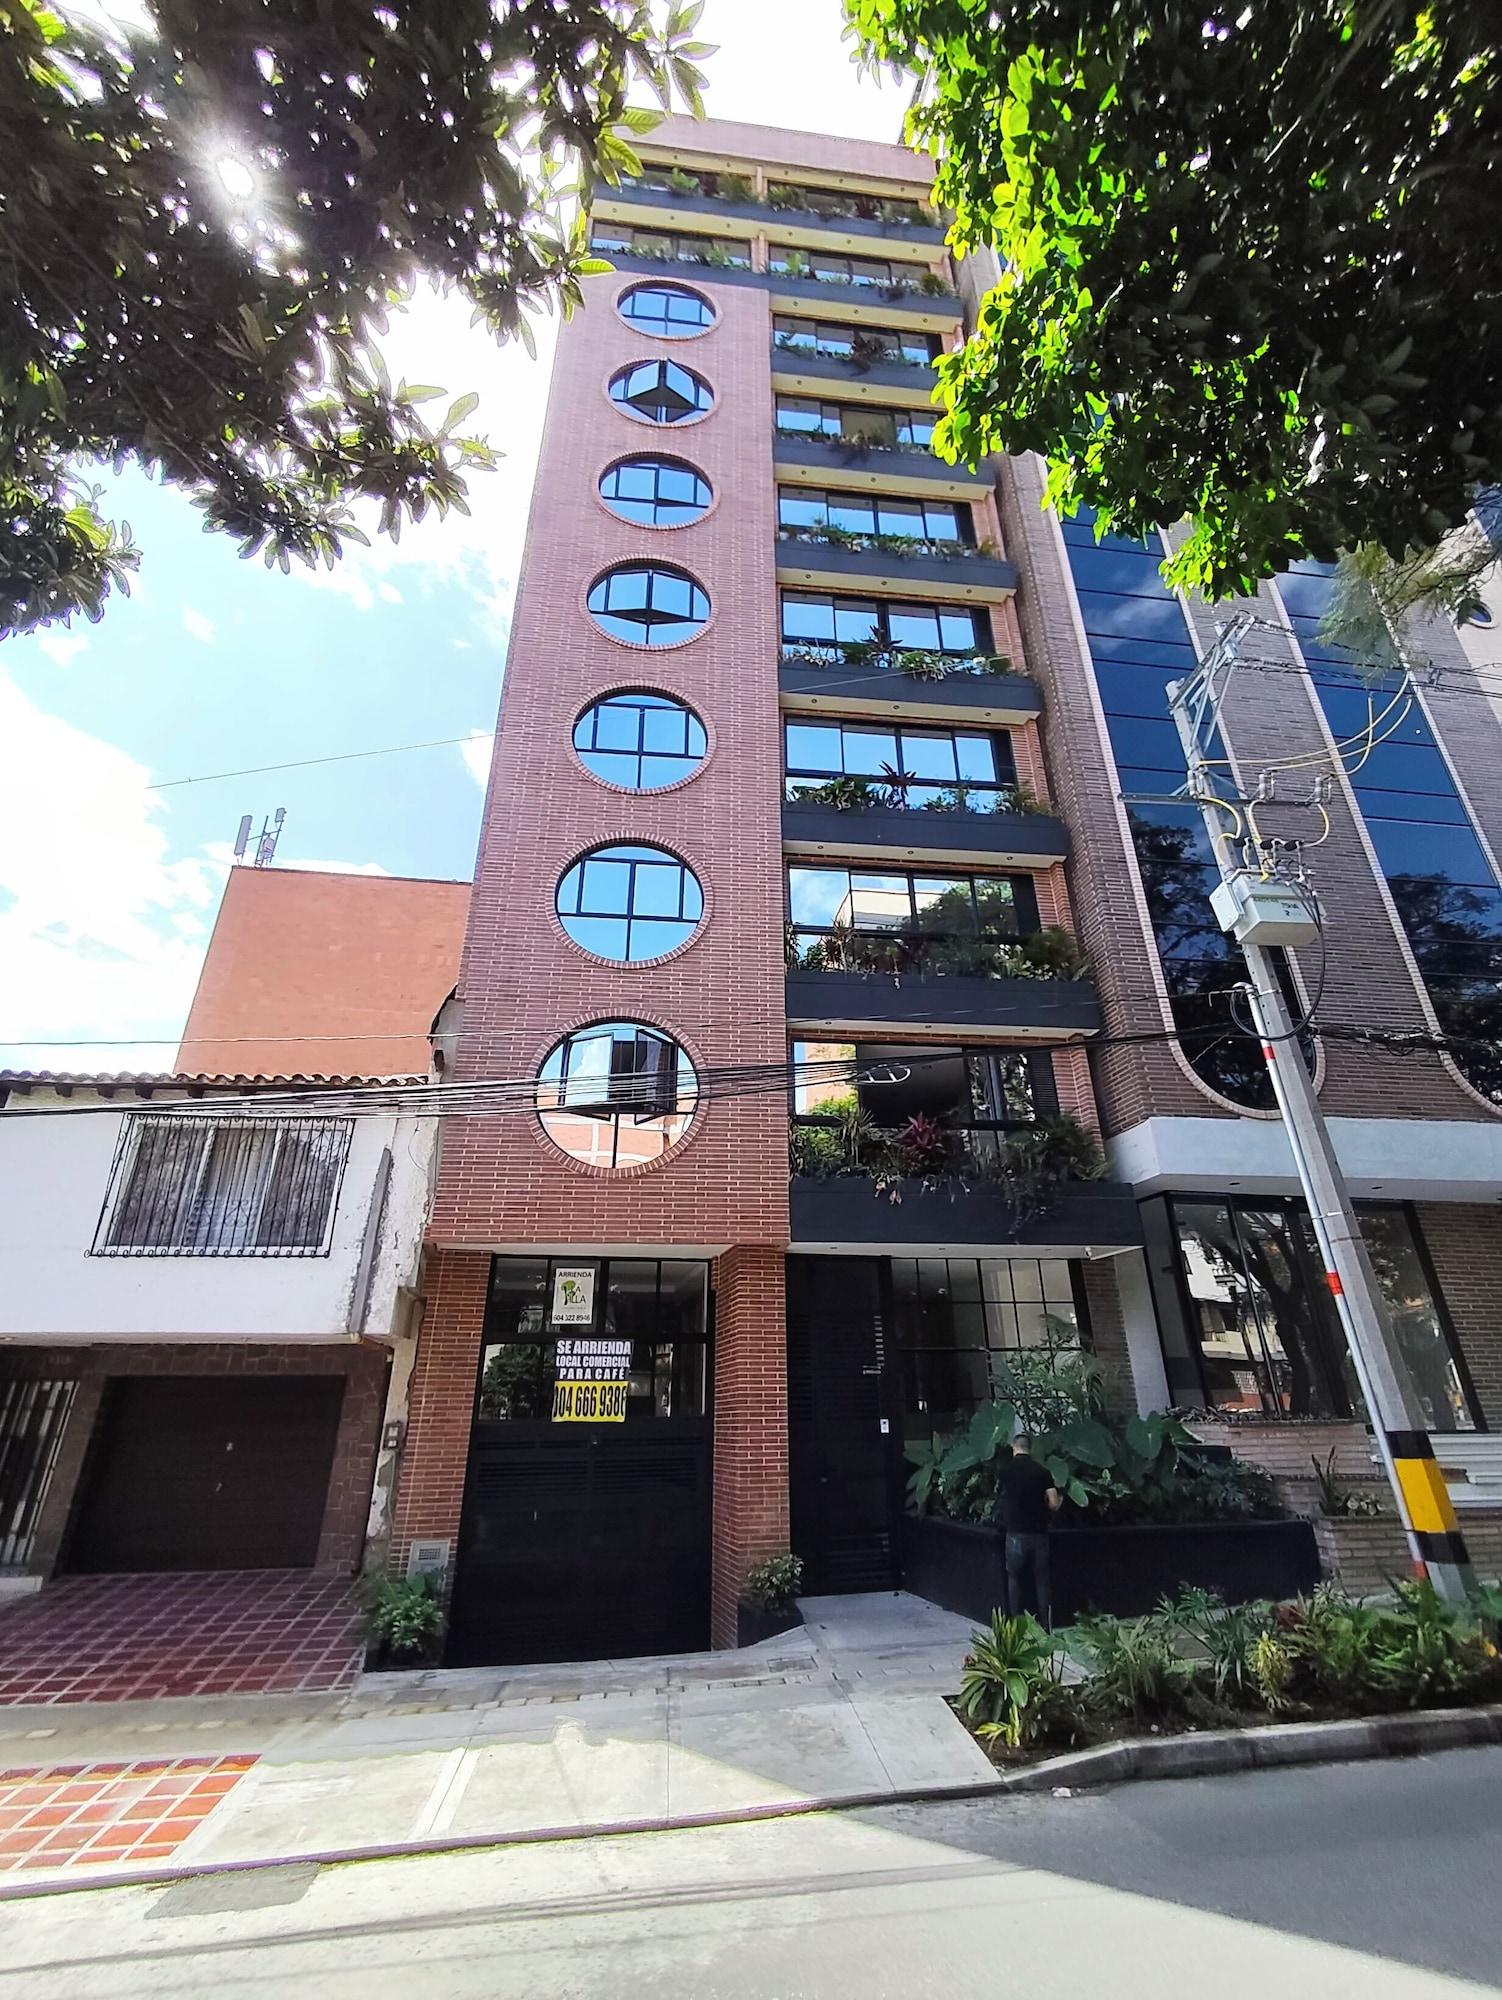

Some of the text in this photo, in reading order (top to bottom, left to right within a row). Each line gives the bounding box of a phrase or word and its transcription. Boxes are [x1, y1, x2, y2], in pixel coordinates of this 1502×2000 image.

[556, 1340, 631, 1355] SE ARRIENDA
[556, 1355, 630, 1368] LOCAL COMERCIAL
[560, 1366, 625, 1380] PARA CAFÉ
[575, 1385, 597, 1417] 666
